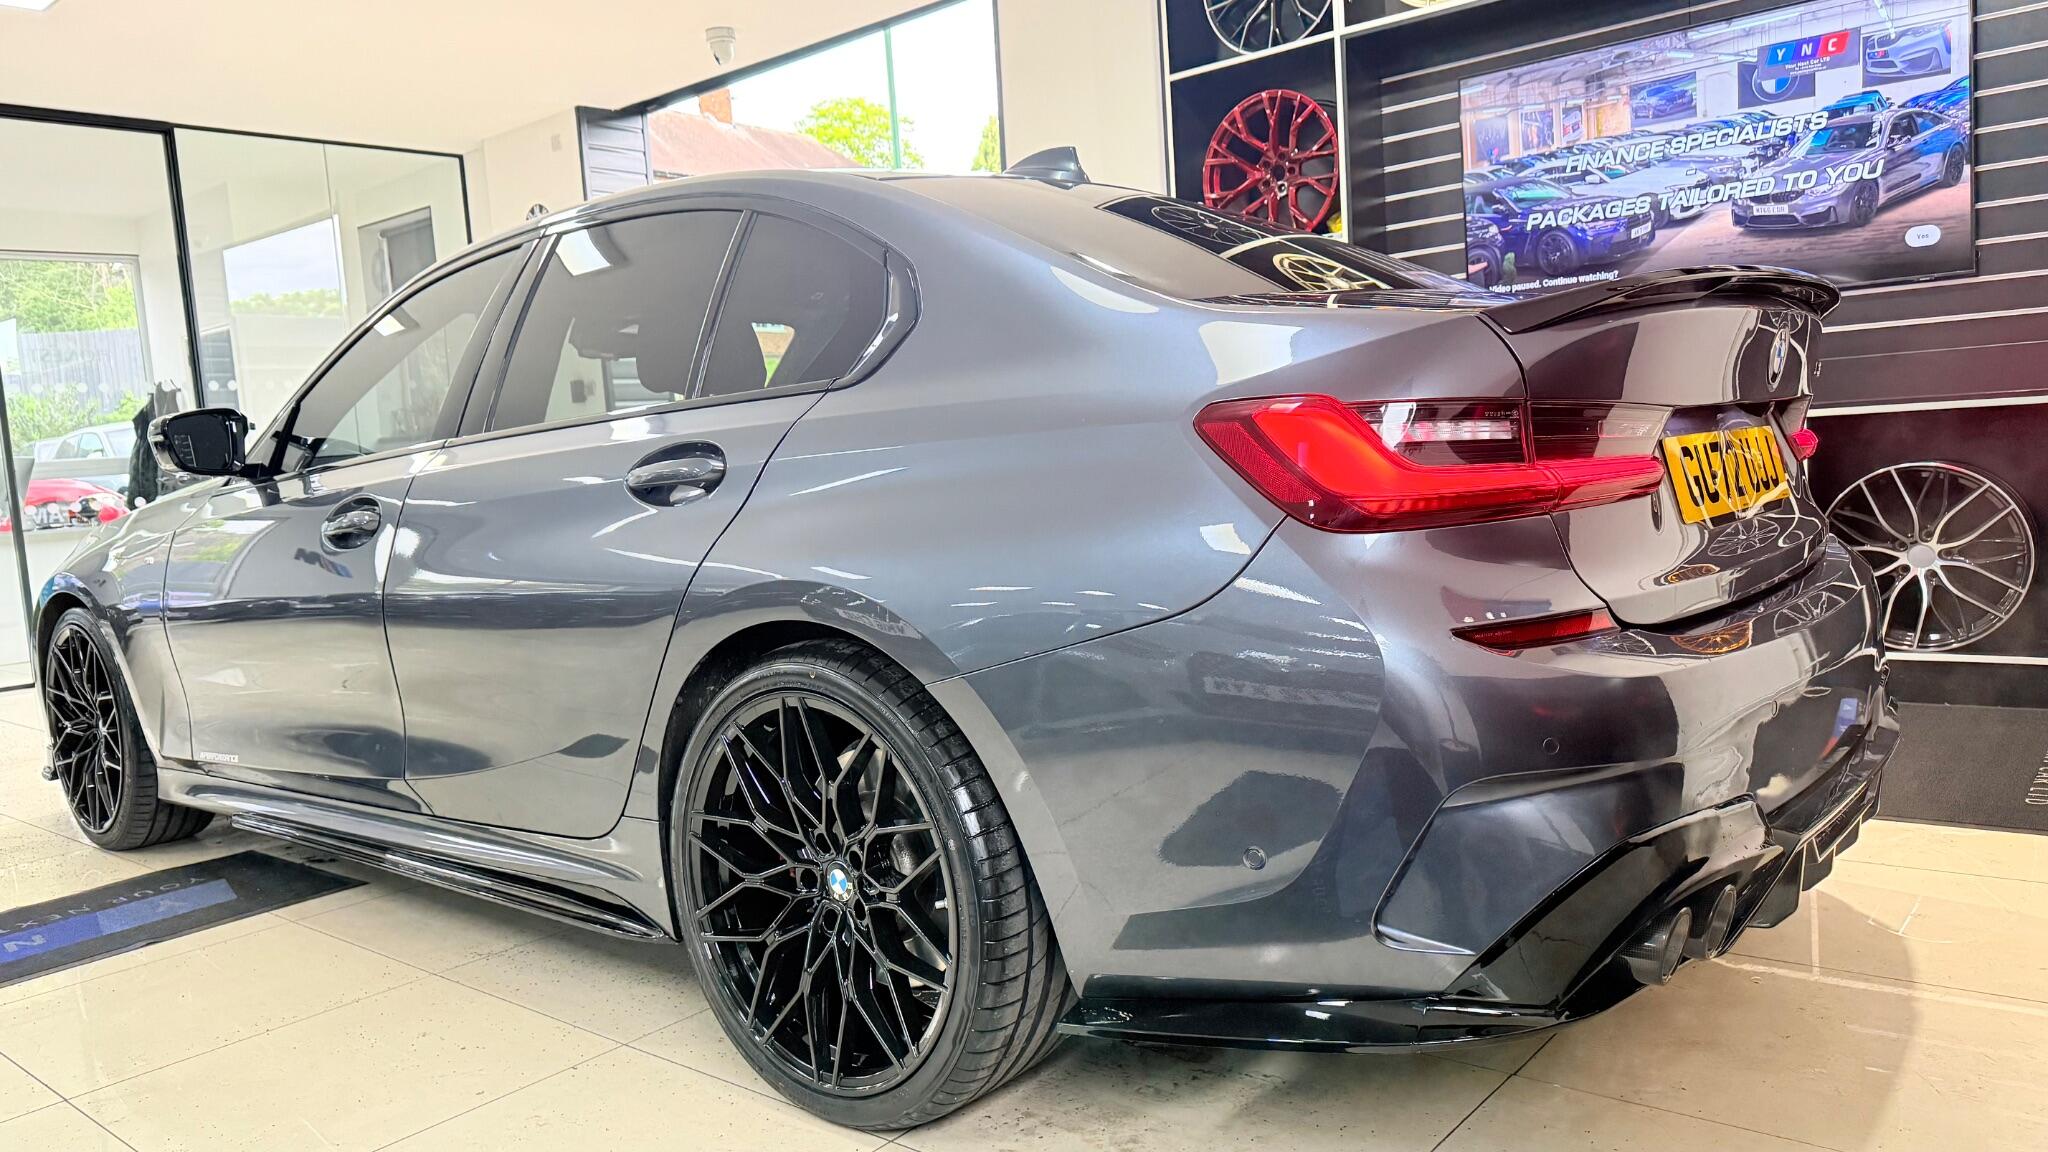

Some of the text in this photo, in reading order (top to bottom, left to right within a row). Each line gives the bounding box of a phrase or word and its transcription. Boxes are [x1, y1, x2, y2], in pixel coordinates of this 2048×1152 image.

[1566, 111, 1829, 172] FINANCE SPECIALISTS
[1527, 159, 1885, 231] PACKAGES TAILORED TO YOU
[1511, 280, 1541, 293] paused.
[1542, 276, 1578, 288] Continue
[1579, 269, 1619, 282] watching?
[1680, 440, 1746, 507] GU72
[111, 876, 206, 904] YOUR
